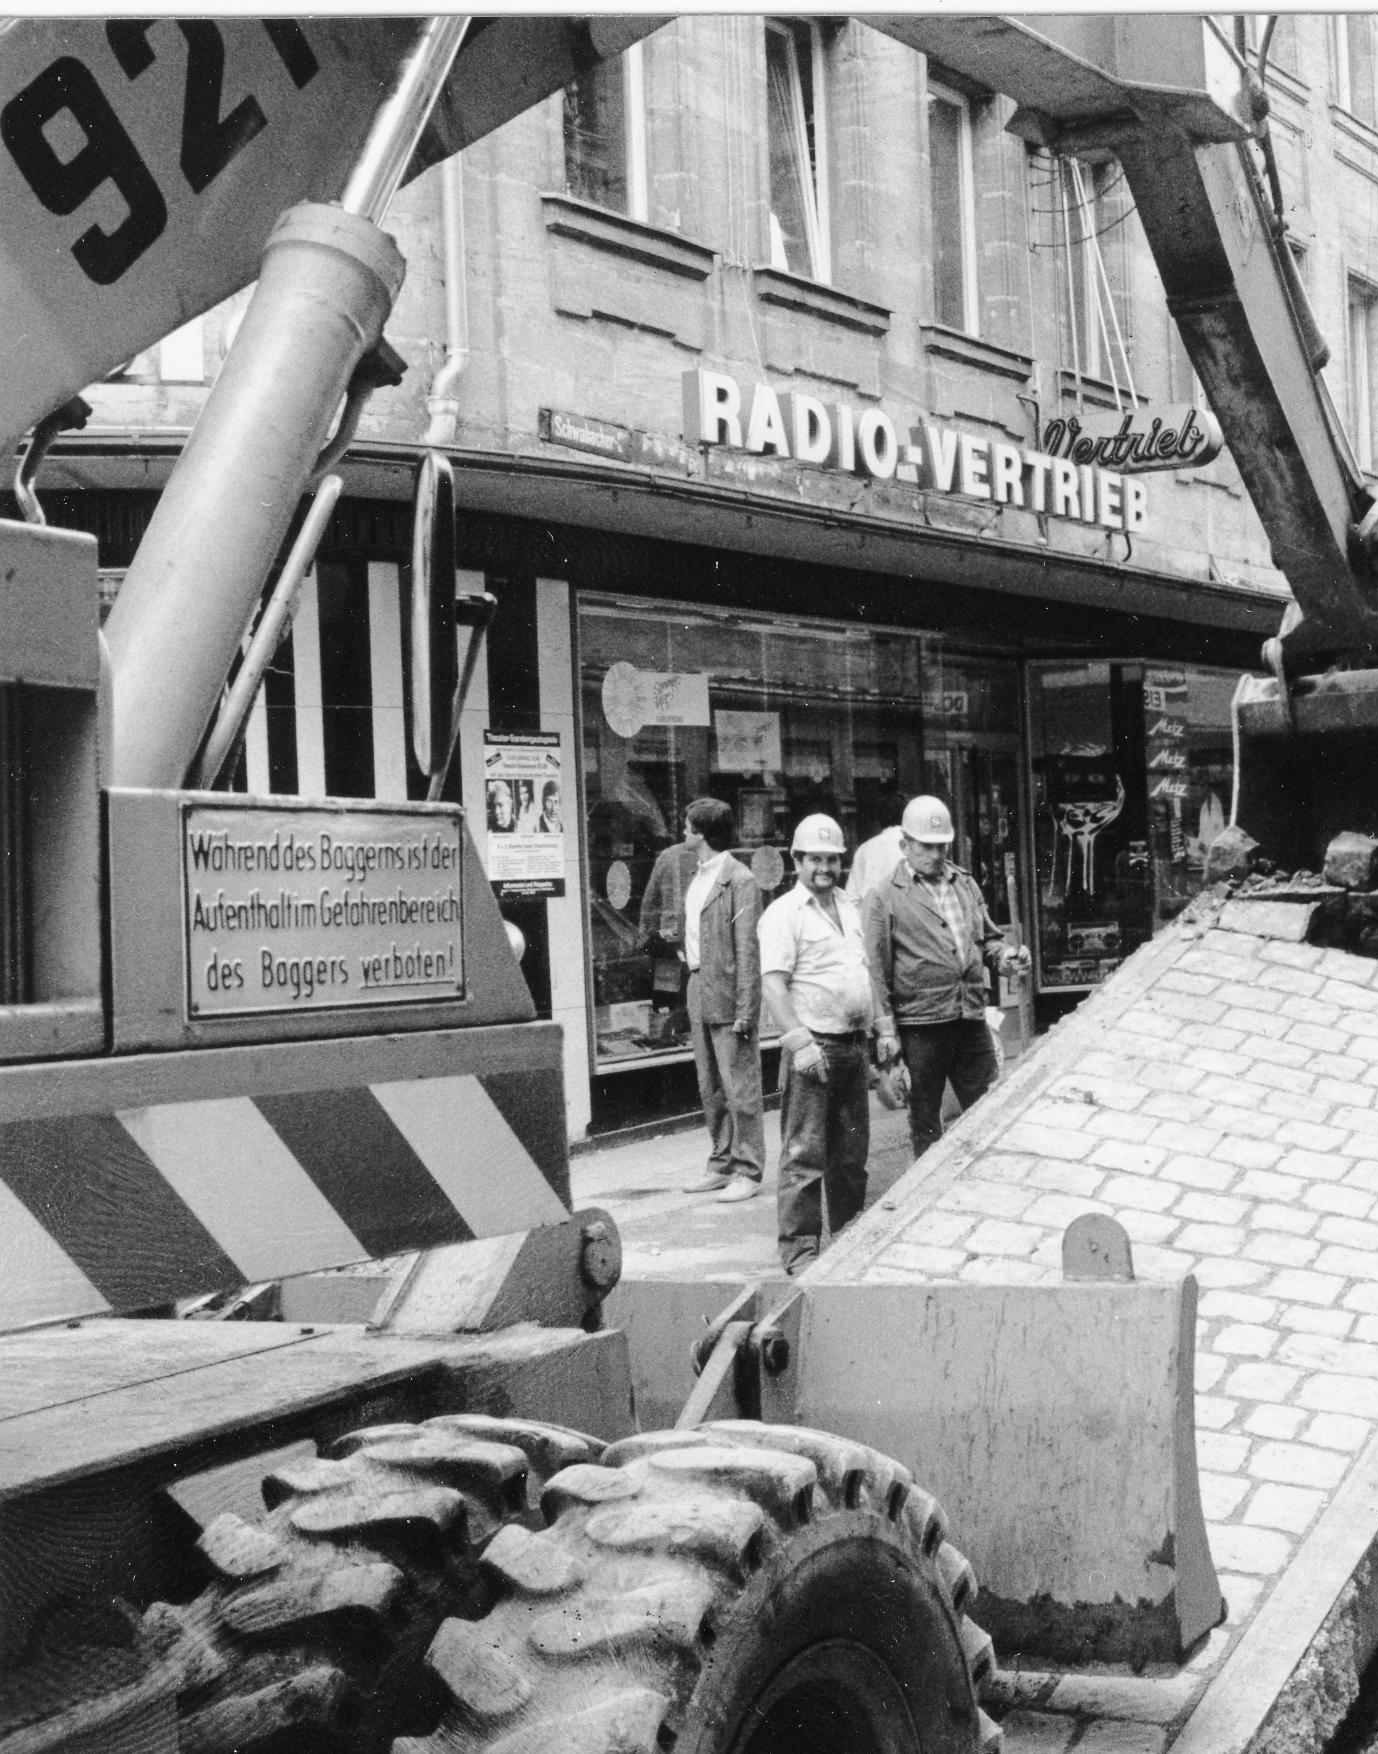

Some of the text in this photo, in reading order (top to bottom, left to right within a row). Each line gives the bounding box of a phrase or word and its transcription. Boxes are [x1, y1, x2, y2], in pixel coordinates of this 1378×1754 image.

[684, 367, 1150, 534] RADIO-VERTRIEB
[1044, 406, 1205, 467] Vertrieb
[1150, 777, 1188, 797] Metz
[283, 833, 316, 871] des
[320, 833, 404, 882] Baggerns
[407, 836, 428, 870] ist
[430, 835, 458, 870] der
[193, 891, 291, 931] Aufenthalt
[294, 895, 317, 928] im
[320, 888, 460, 927] Gefahrenbereich
[206, 944, 454, 1000] des Baggers verboten!
